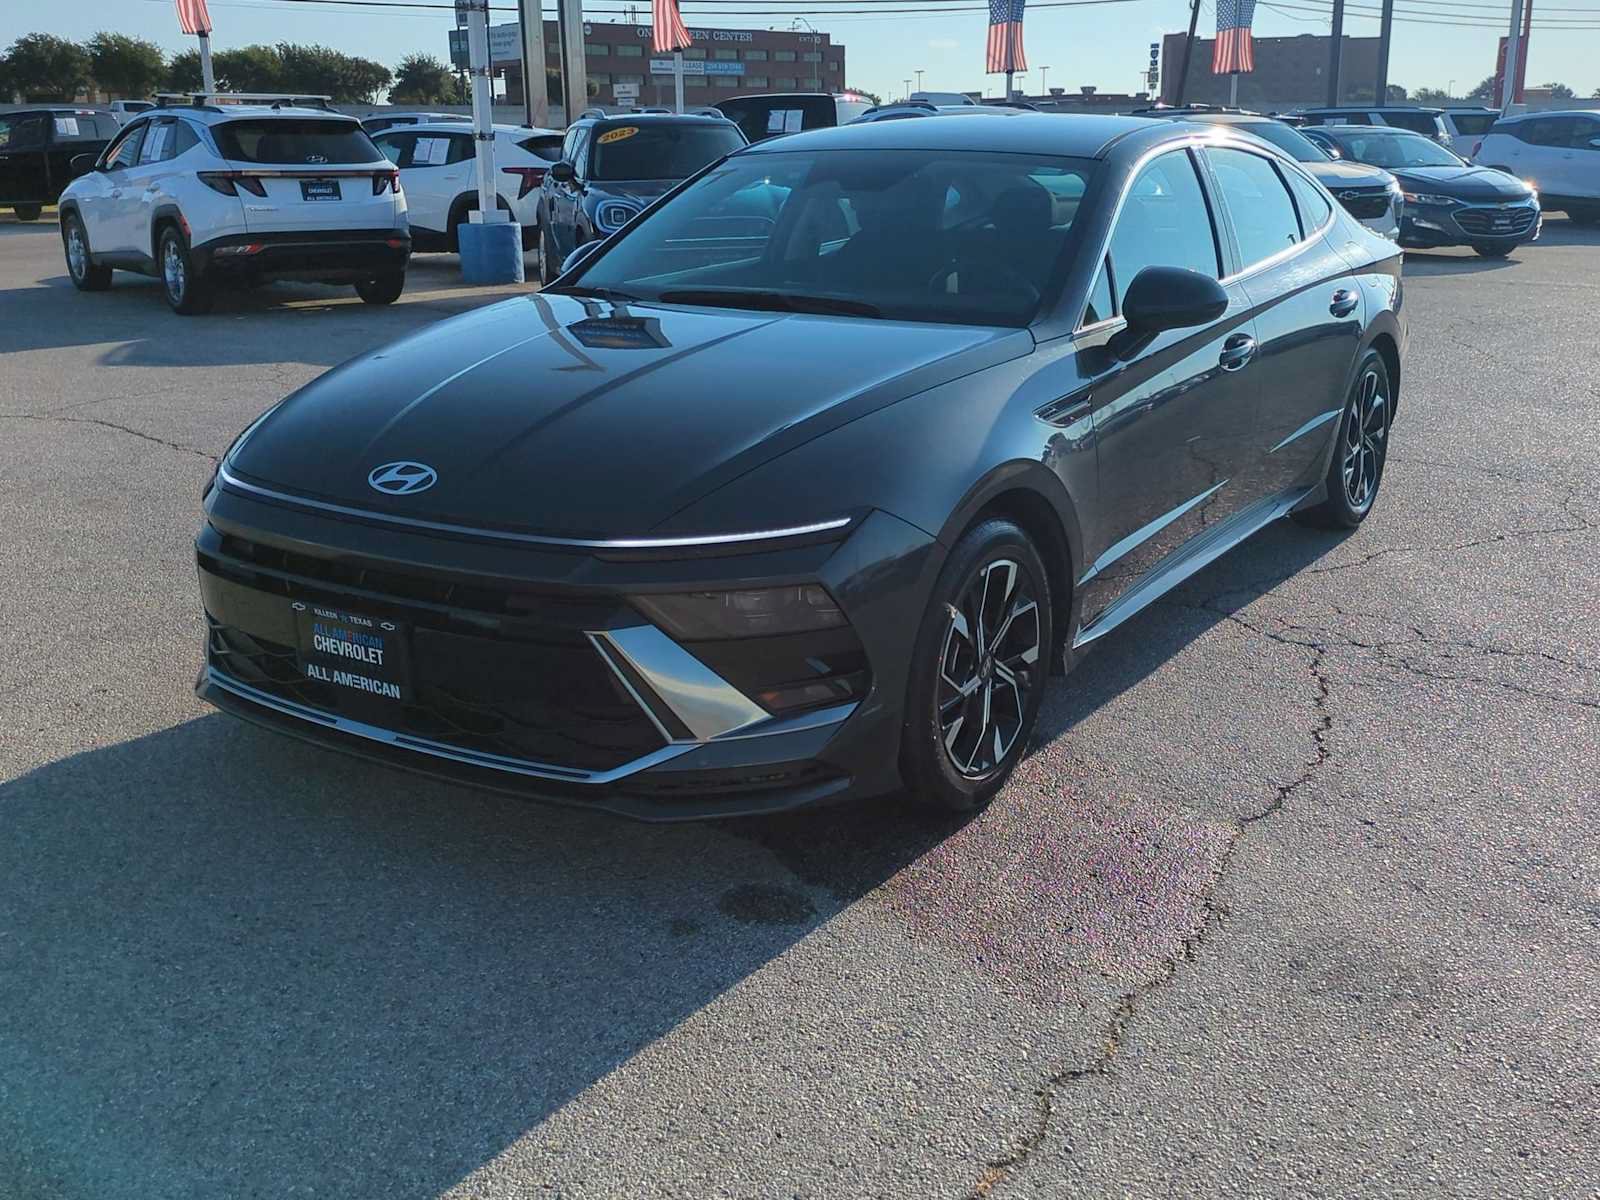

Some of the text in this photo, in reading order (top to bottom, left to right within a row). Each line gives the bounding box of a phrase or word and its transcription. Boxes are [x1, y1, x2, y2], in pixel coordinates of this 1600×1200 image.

[637, 27, 653, 38] ON
[713, 31, 752, 42] CENTER
[602, 128, 634, 141] 2023
[313, 608, 372, 627] KILLEEN TEXAS
[314, 624, 384, 648] ALL AMERICAN
[314, 635, 384, 665] CHEVROLET
[307, 664, 400, 698] ALL AMERICAN
